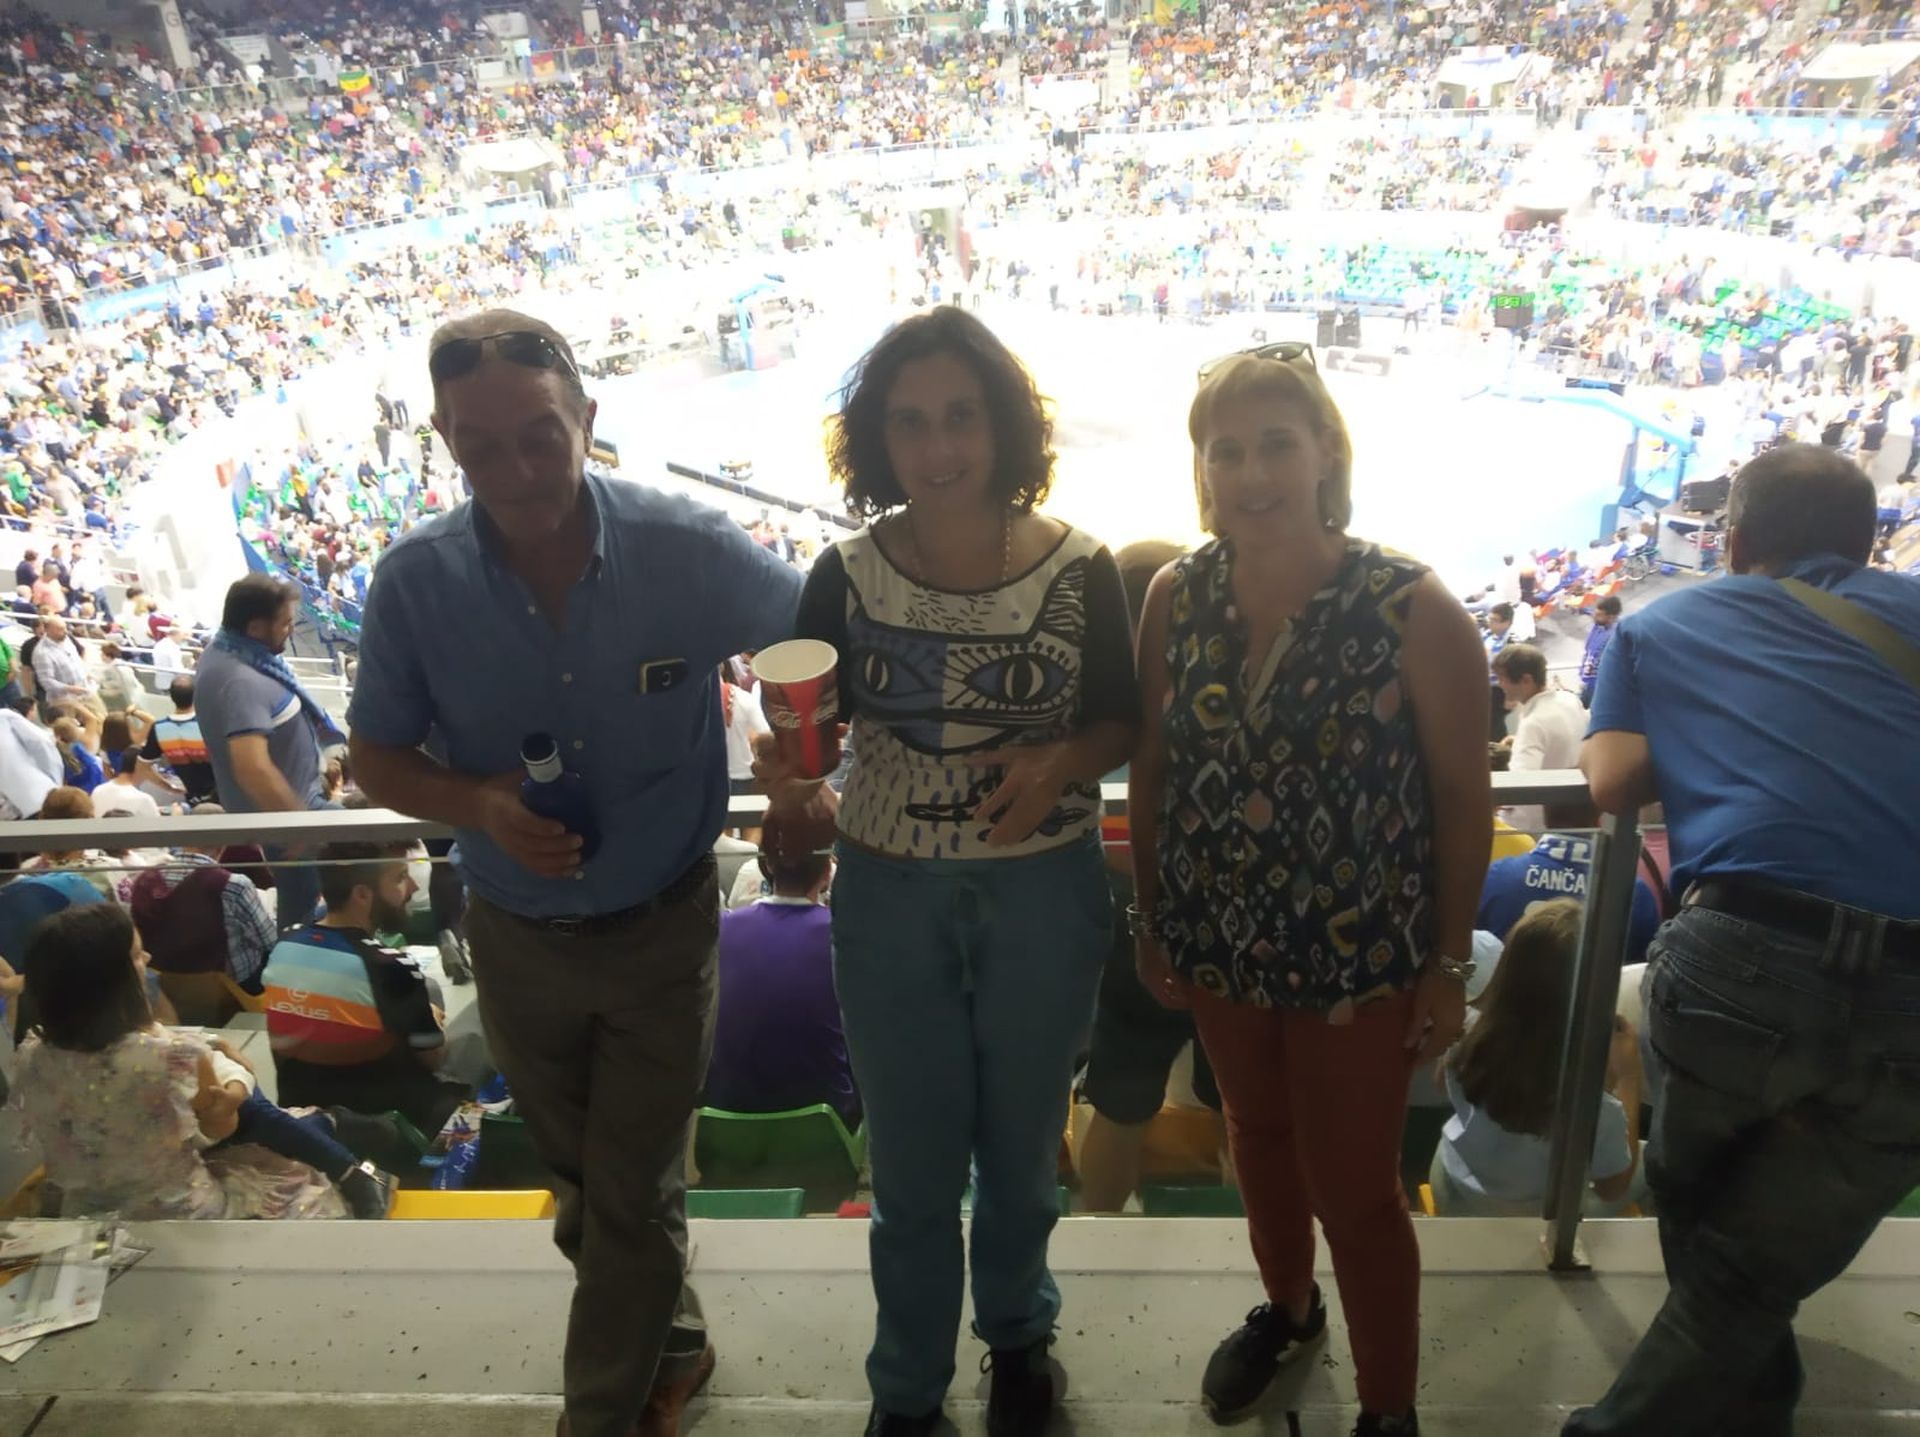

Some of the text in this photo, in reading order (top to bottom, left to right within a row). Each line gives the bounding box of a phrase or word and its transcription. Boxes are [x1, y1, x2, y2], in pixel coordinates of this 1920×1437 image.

[166, 12, 180, 27] G
[1525, 864, 1585, 894] ČANČA
[270, 1000, 330, 1019] LEXUS
